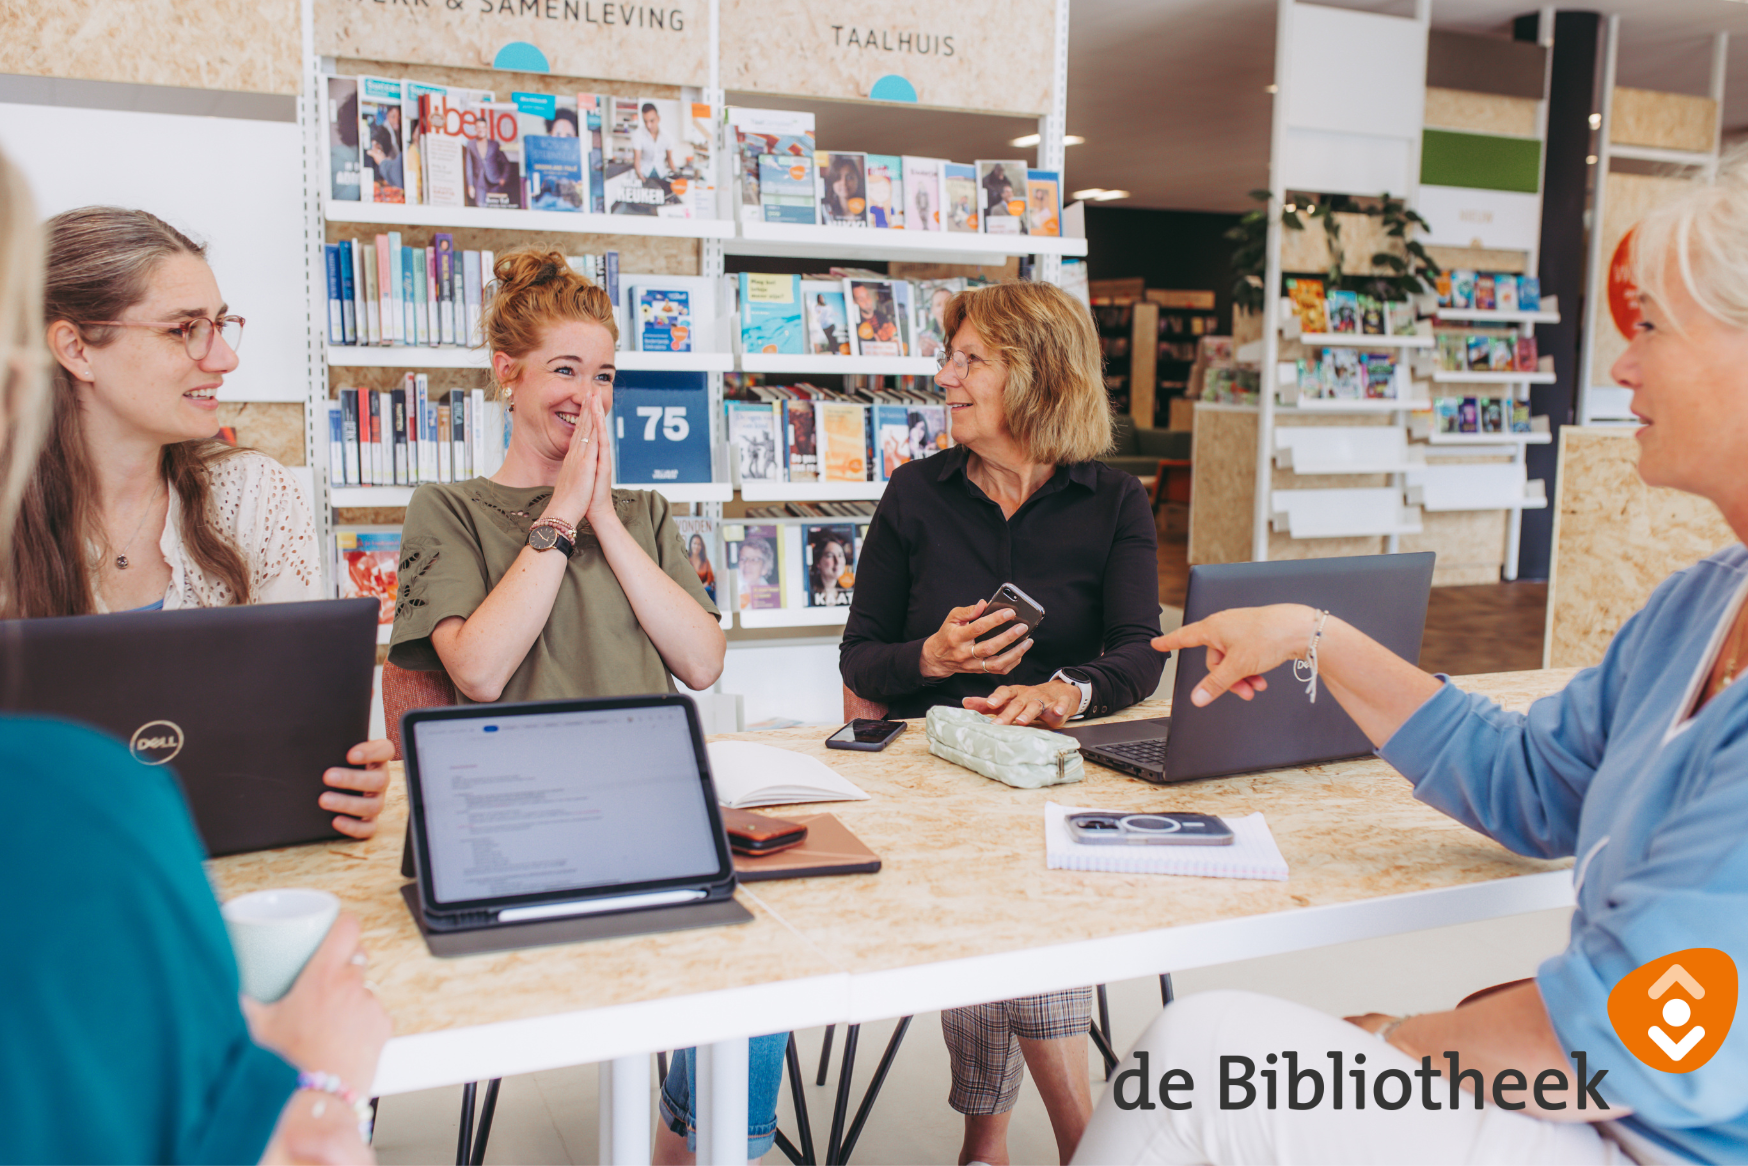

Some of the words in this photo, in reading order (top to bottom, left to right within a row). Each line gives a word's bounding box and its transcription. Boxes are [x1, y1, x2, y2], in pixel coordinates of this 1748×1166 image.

[480, 0, 683, 31] SAMENLEVING
[831, 25, 954, 56] TAALHUIS
[615, 186, 665, 205] KEUKEN
[636, 406, 690, 442] 75
[137, 736, 178, 751] DELL
